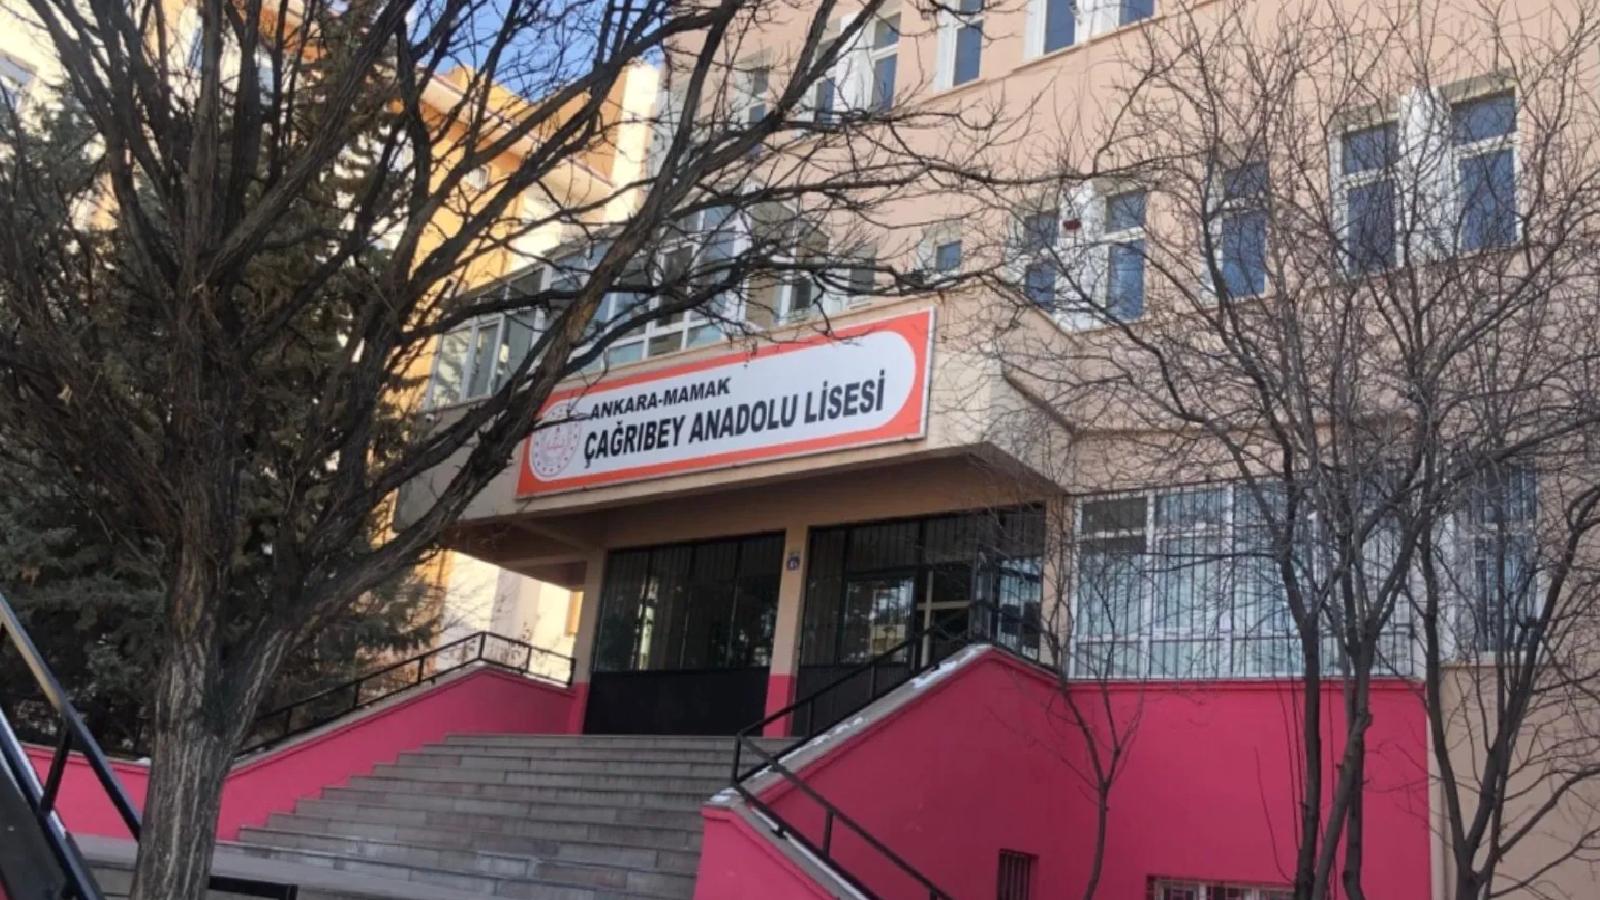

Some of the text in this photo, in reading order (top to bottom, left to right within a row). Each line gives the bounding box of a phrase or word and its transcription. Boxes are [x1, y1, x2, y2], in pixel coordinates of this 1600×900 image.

[583, 370, 886, 469] ÇAĞRIBEY ANADOLU LİSESİ
[590, 378, 731, 419] ANKARA-MAMAK
